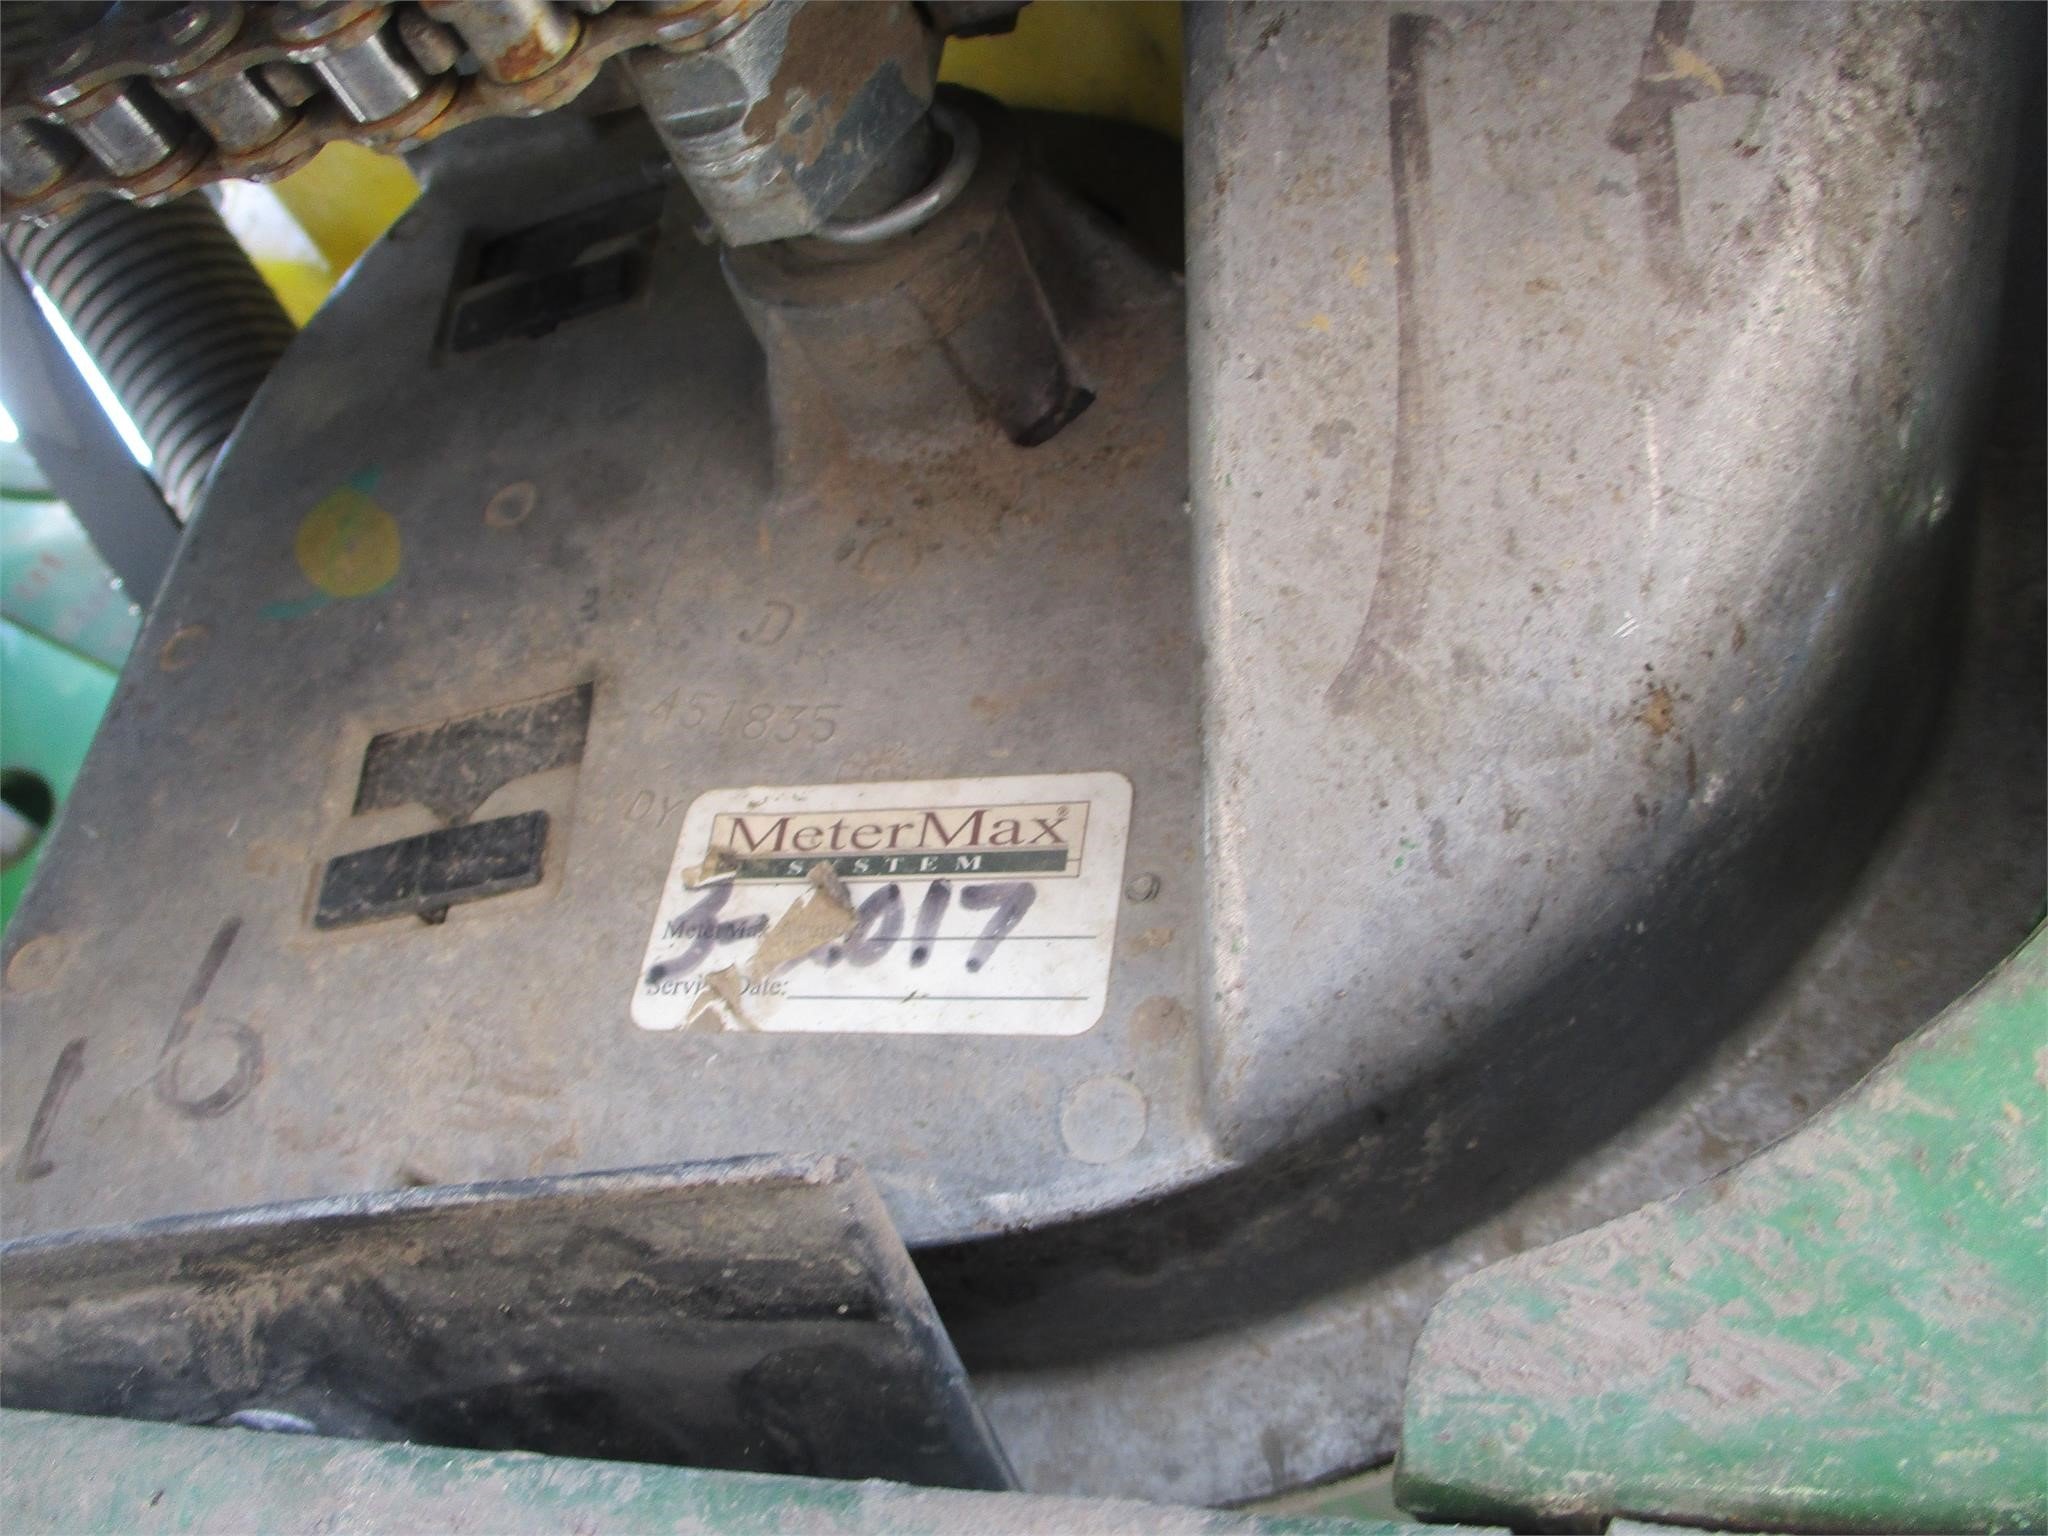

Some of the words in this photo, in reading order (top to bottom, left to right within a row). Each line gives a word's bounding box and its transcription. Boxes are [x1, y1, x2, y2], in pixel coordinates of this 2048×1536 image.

[728, 808, 1069, 853] MeterMax
[785, 854, 984, 877] SSTEM
[646, 976, 724, 995] Servi
